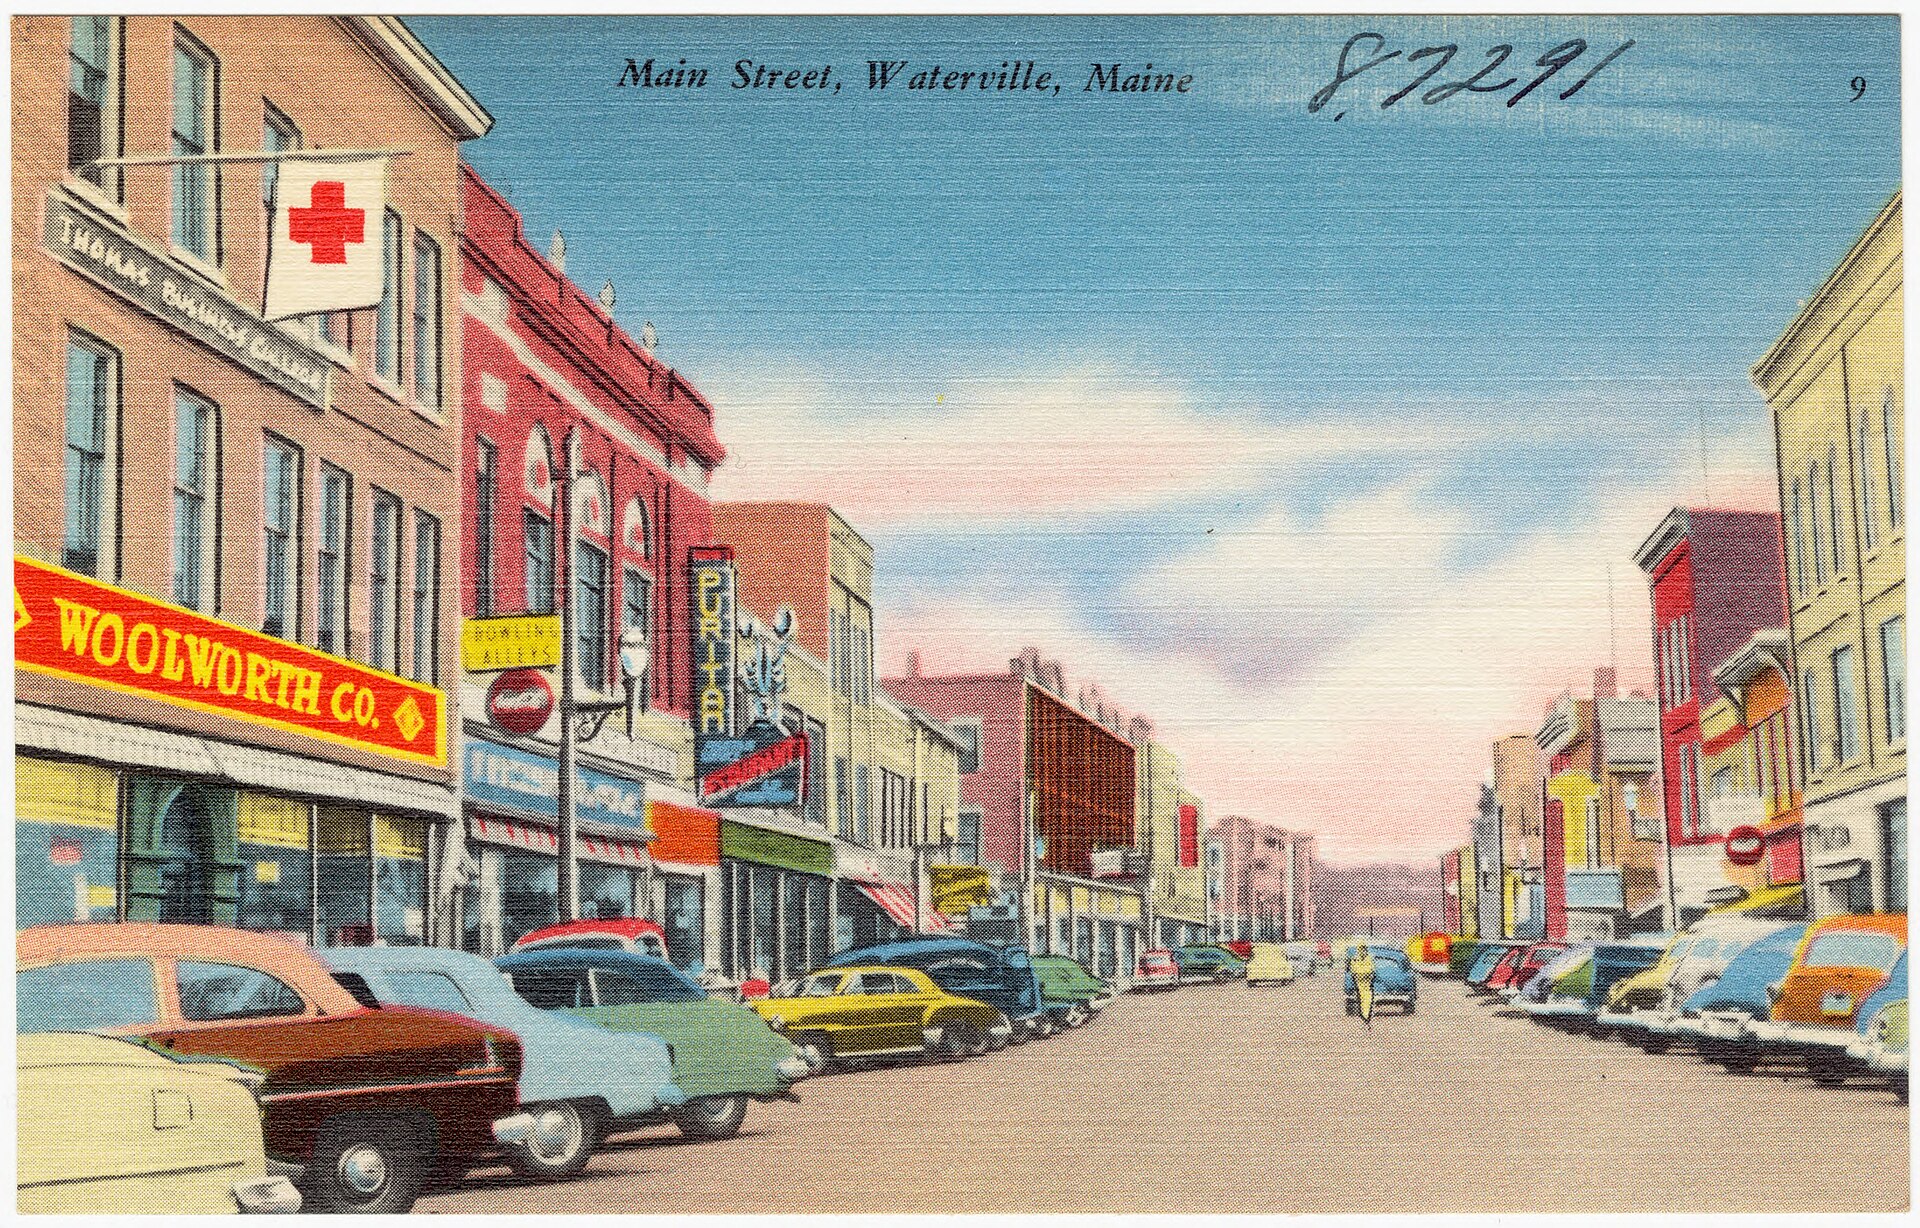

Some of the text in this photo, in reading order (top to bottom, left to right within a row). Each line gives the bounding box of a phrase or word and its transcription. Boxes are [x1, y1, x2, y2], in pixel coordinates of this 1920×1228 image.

[59, 214, 150, 288] THOMAS
[473, 622, 560, 643] BOWLING
[482, 645, 552, 666] ALLEYS
[54, 597, 380, 729] WOOLWORTH CO.
